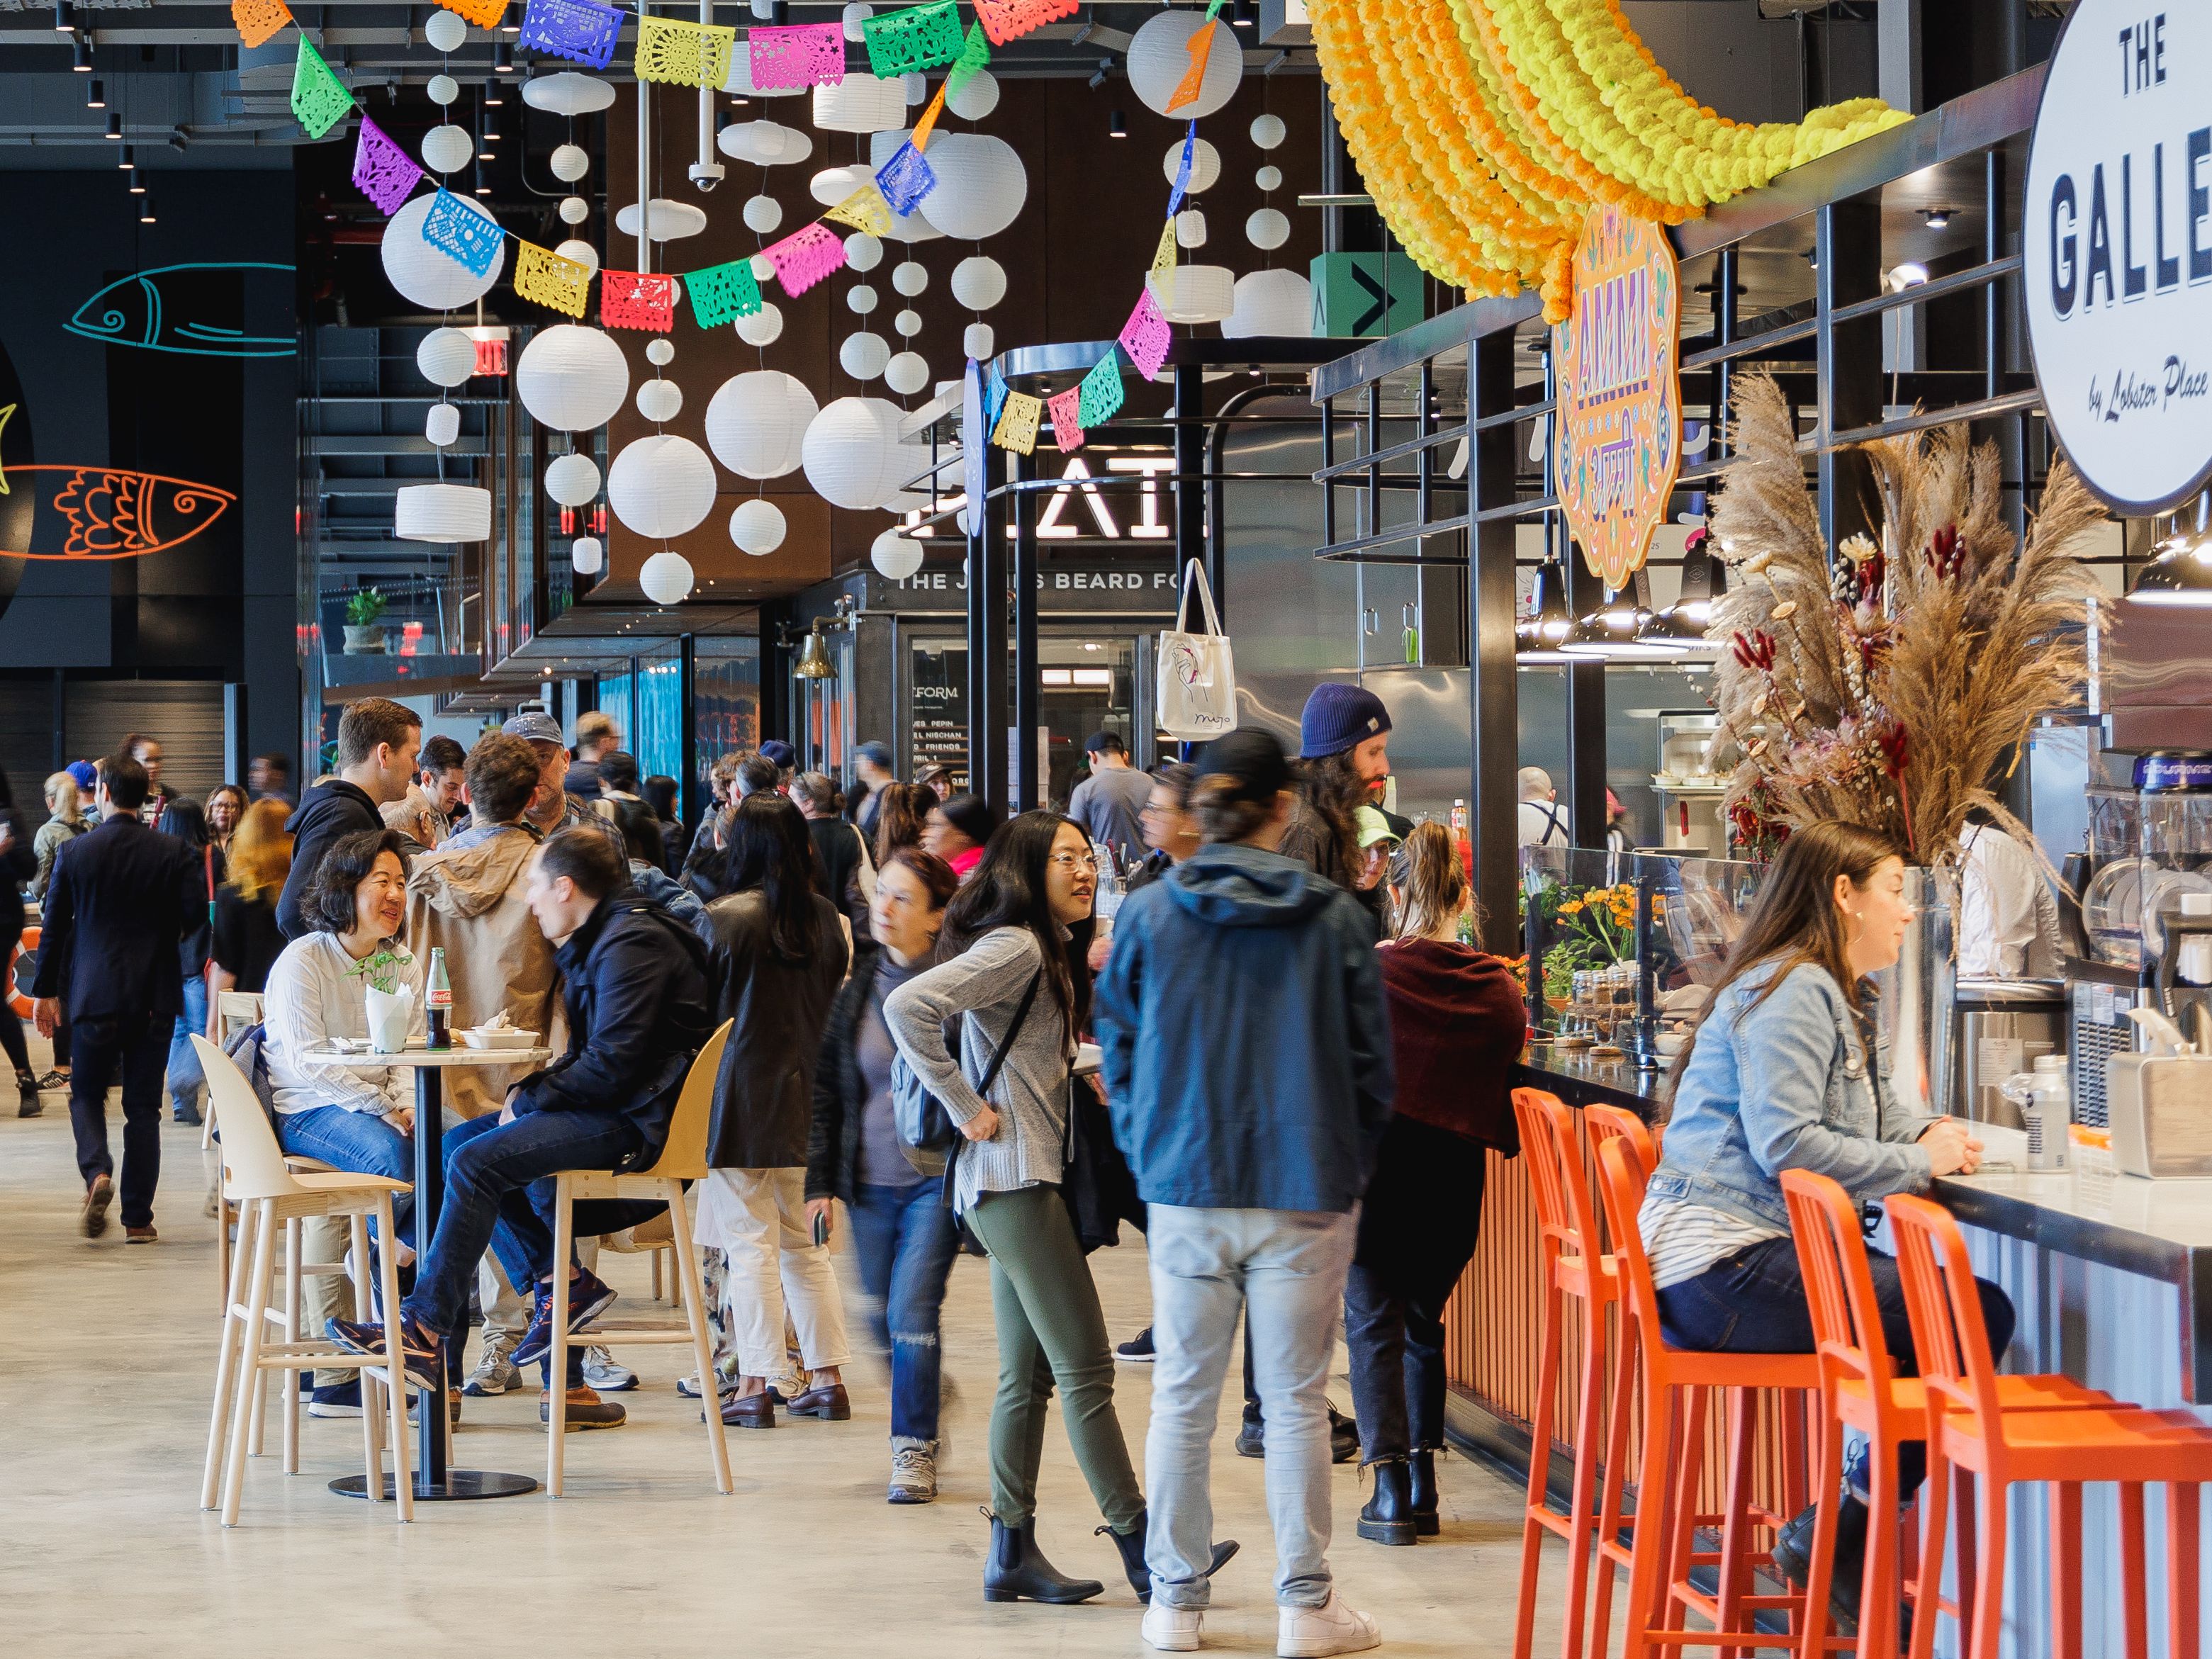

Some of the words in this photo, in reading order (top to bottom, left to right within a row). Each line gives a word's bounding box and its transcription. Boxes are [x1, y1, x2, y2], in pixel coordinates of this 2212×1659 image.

[2119, 13, 2166, 98] THE
[2049, 125, 2212, 321] GALLE
[1577, 264, 1649, 408] AMMI
[2089, 373, 2103, 422] by
[2104, 368, 2157, 422] Lobster
[2162, 354, 2208, 413] Place
[1055, 573, 1143, 589] BEARD
